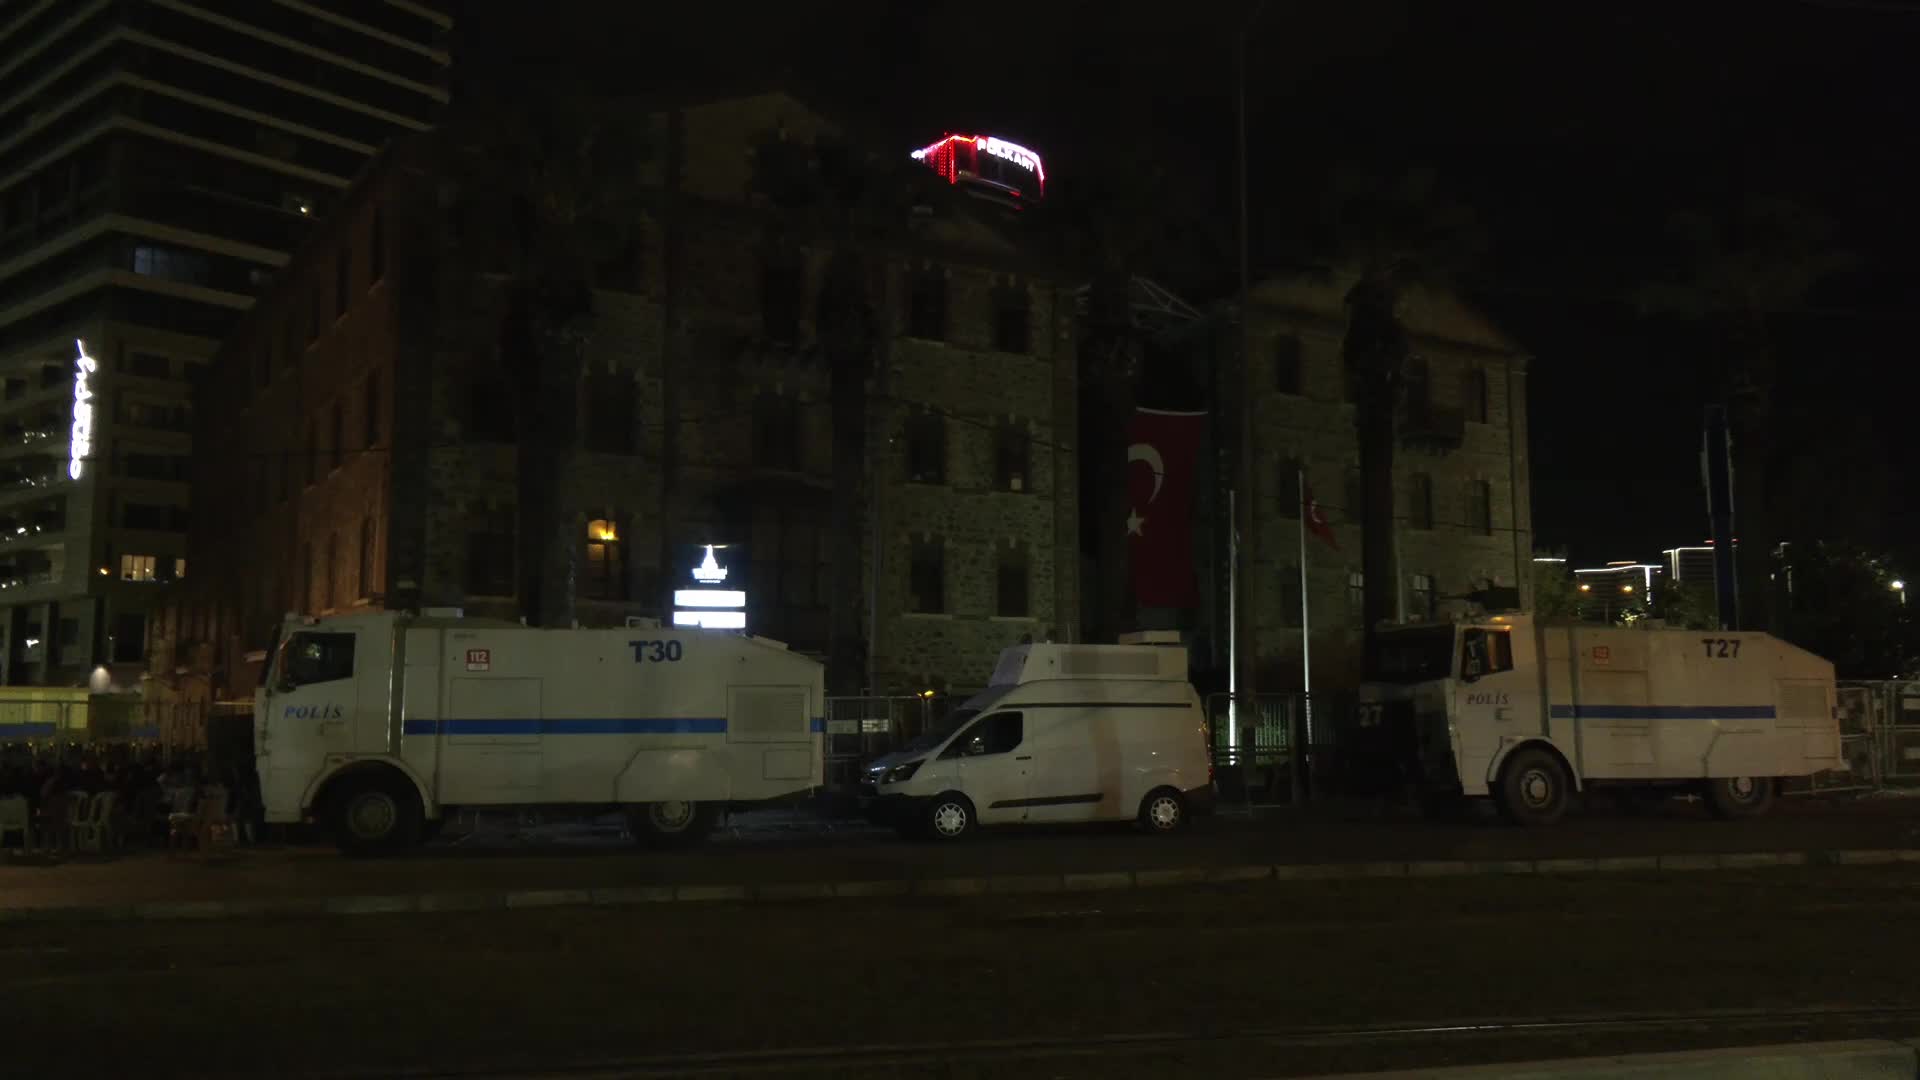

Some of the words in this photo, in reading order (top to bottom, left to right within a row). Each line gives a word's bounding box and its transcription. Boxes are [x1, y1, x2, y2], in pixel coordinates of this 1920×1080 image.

[469, 650, 488, 663] 112
[629, 640, 682, 663] T30
[1702, 638, 1741, 658] T27
